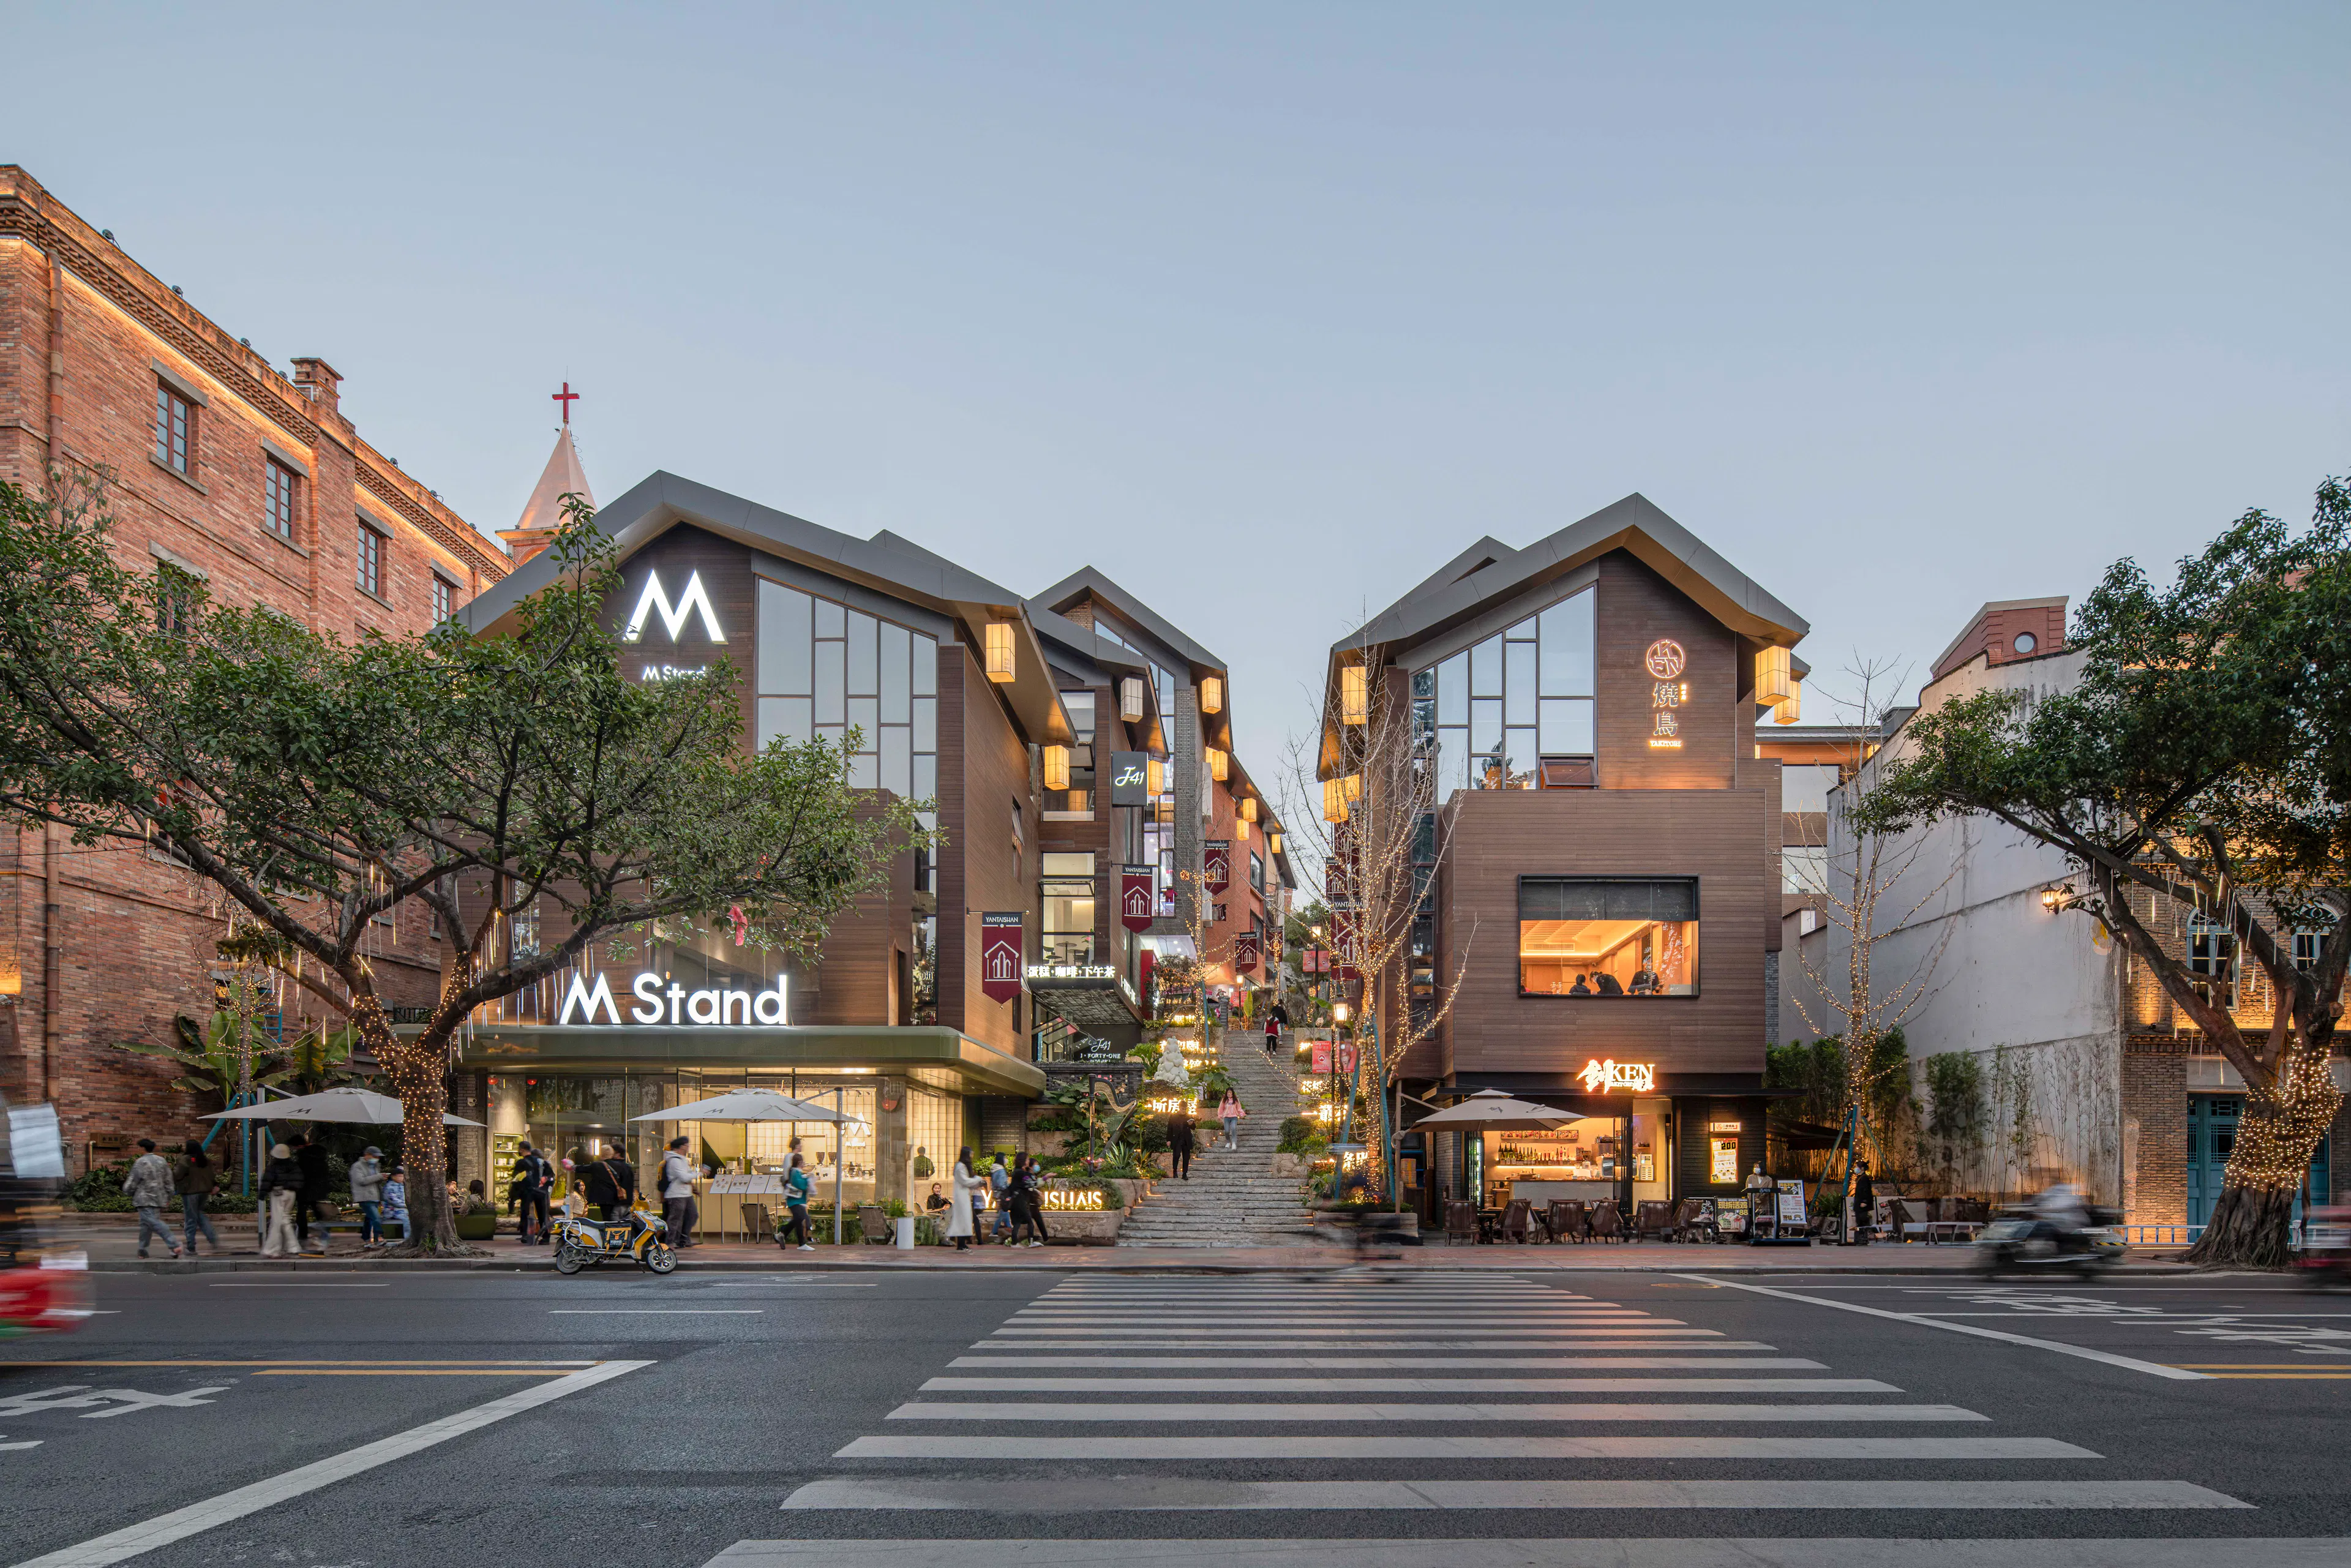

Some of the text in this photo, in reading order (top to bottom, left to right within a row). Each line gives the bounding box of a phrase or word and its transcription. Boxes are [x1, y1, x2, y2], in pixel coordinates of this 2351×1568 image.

[622, 568, 729, 645] M
[642, 665, 660, 680] M
[559, 971, 787, 1024] M Stand
[1610, 1063, 1655, 1082] KEN
